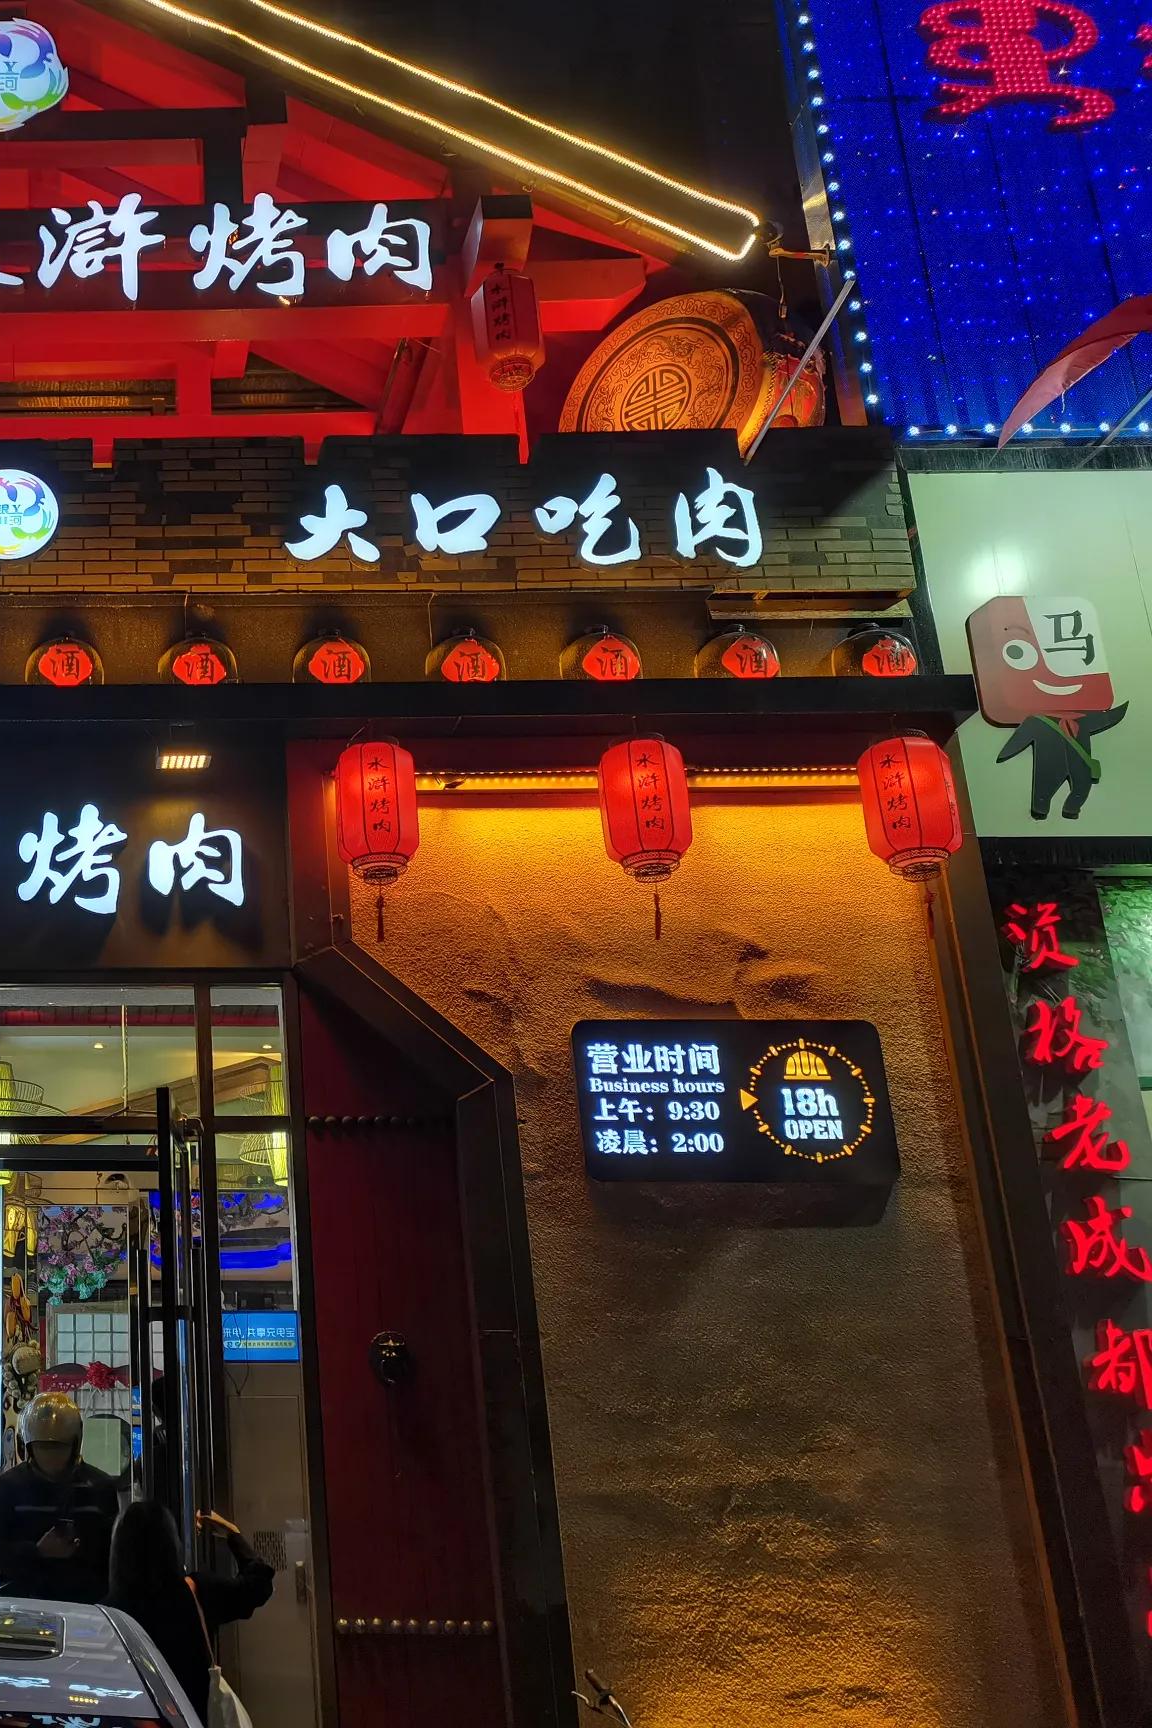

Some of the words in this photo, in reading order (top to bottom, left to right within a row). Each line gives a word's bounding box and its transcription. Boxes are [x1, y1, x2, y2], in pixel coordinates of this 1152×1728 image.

[285, 468, 762, 567] 大口吃肉
[1042, 610, 1095, 666] 马
[51, 650, 80, 679] 酒
[185, 652, 214, 682] 酒
[322, 650, 351, 679] 酒
[456, 650, 486, 680] 酒
[600, 647, 629, 677] 酒
[736, 647, 765, 675] 酒
[874, 647, 905, 675] 酒
[587, 1043, 720, 1075] 营业时间
[589, 1078, 669, 1094] Business
[673, 1079, 725, 1094] hours
[781, 1087, 840, 1117] 18h
[784, 1119, 844, 1140] OPEN
